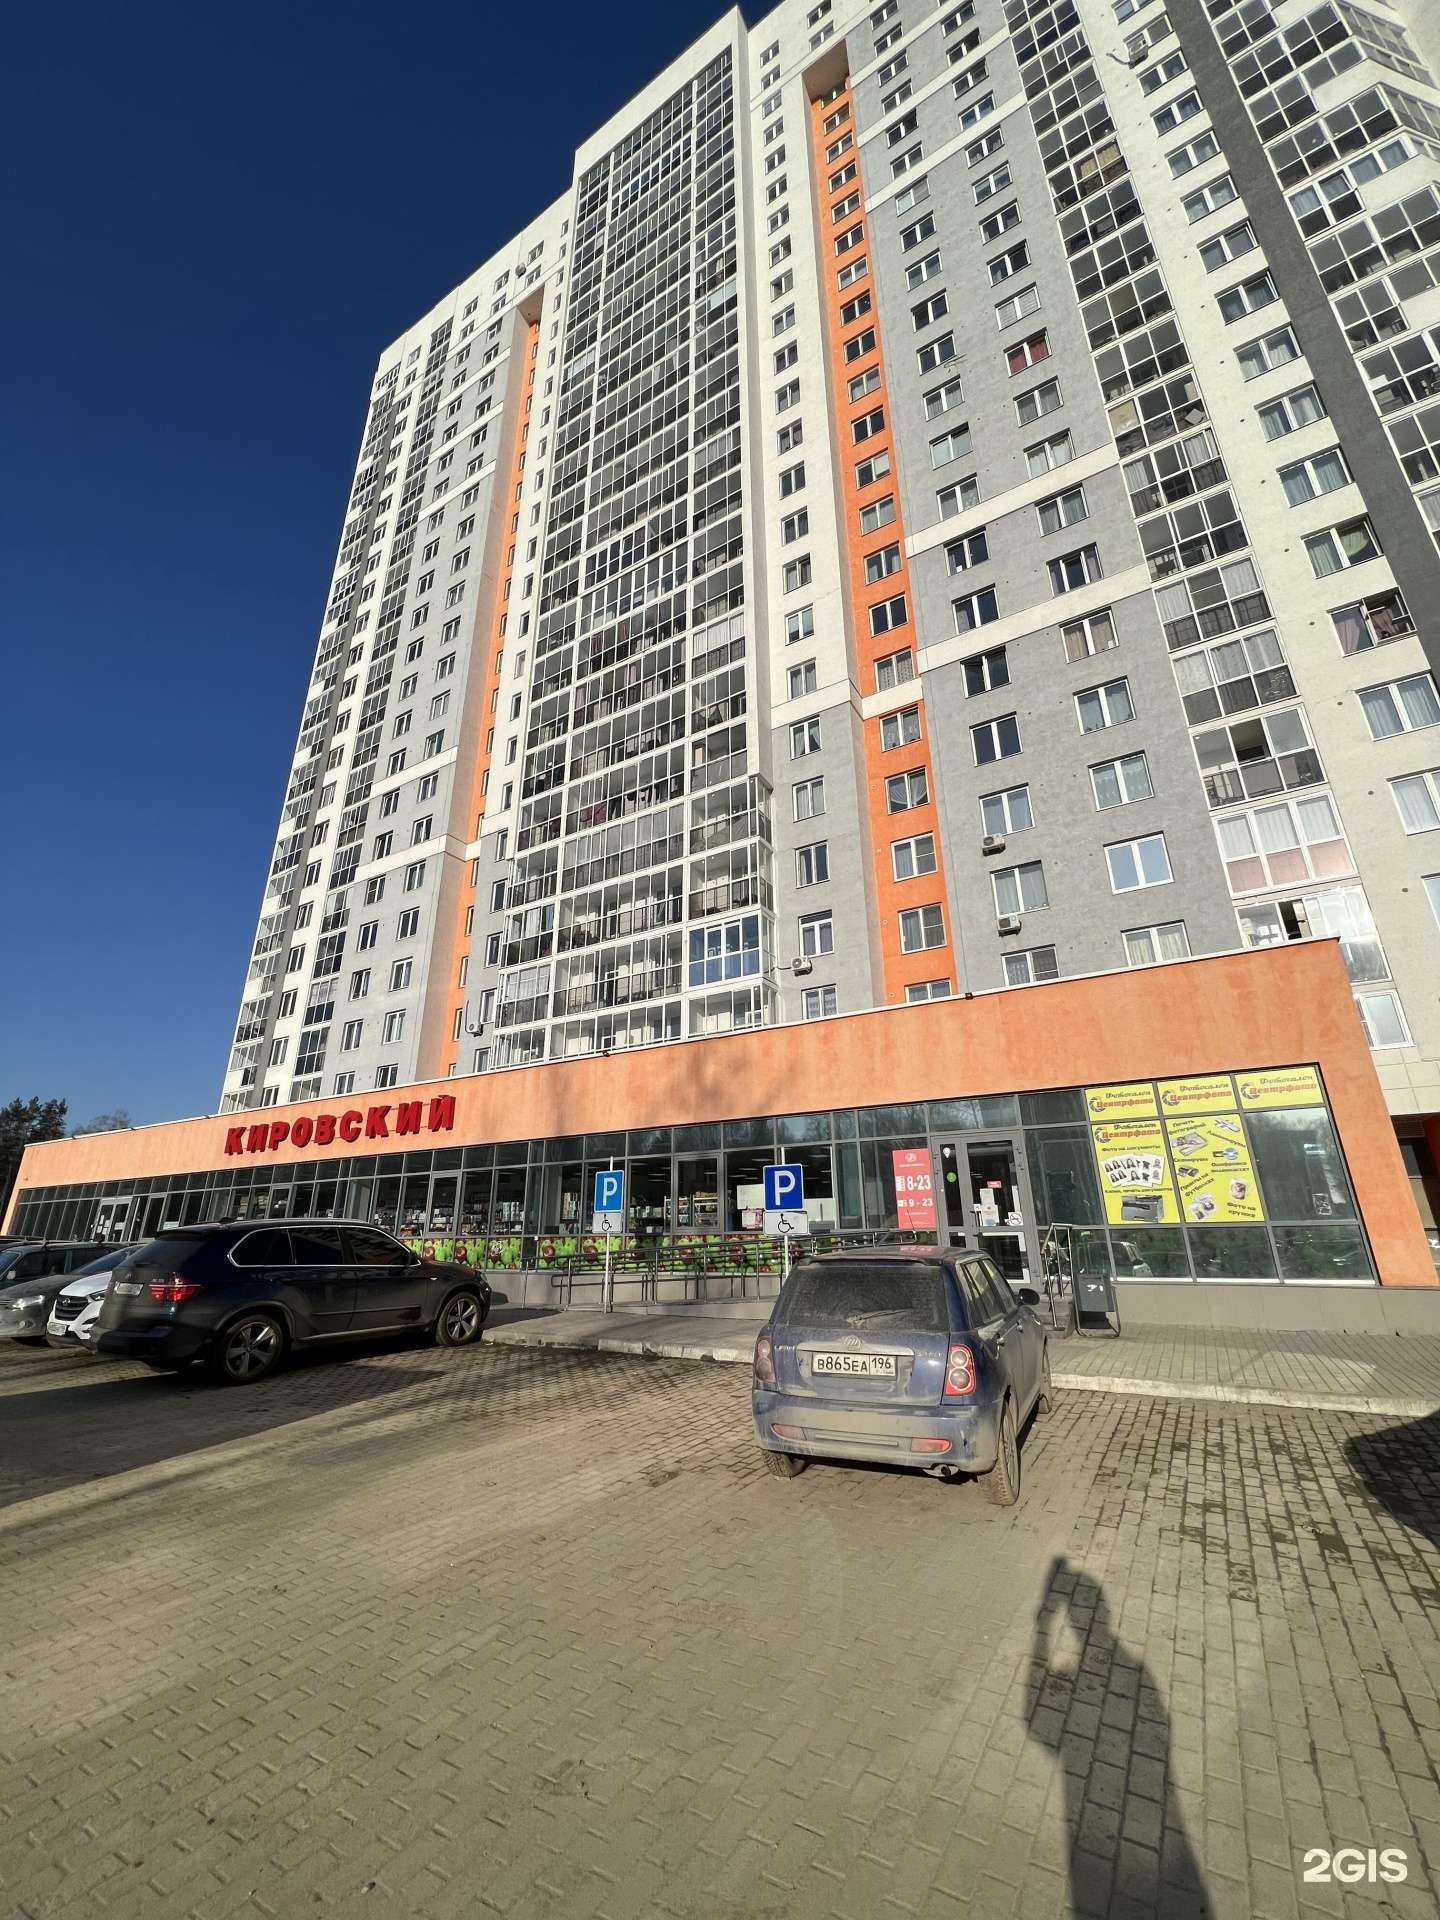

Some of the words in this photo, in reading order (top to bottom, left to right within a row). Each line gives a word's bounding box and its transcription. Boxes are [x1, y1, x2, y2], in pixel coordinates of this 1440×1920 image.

[224, 1094, 456, 1156] КИРОВСКИЙ
[602, 1177, 618, 1206] P
[774, 1170, 796, 1206] P
[817, 1356, 868, 1373] В865ЕА
[871, 1357, 891, 1369] 196
